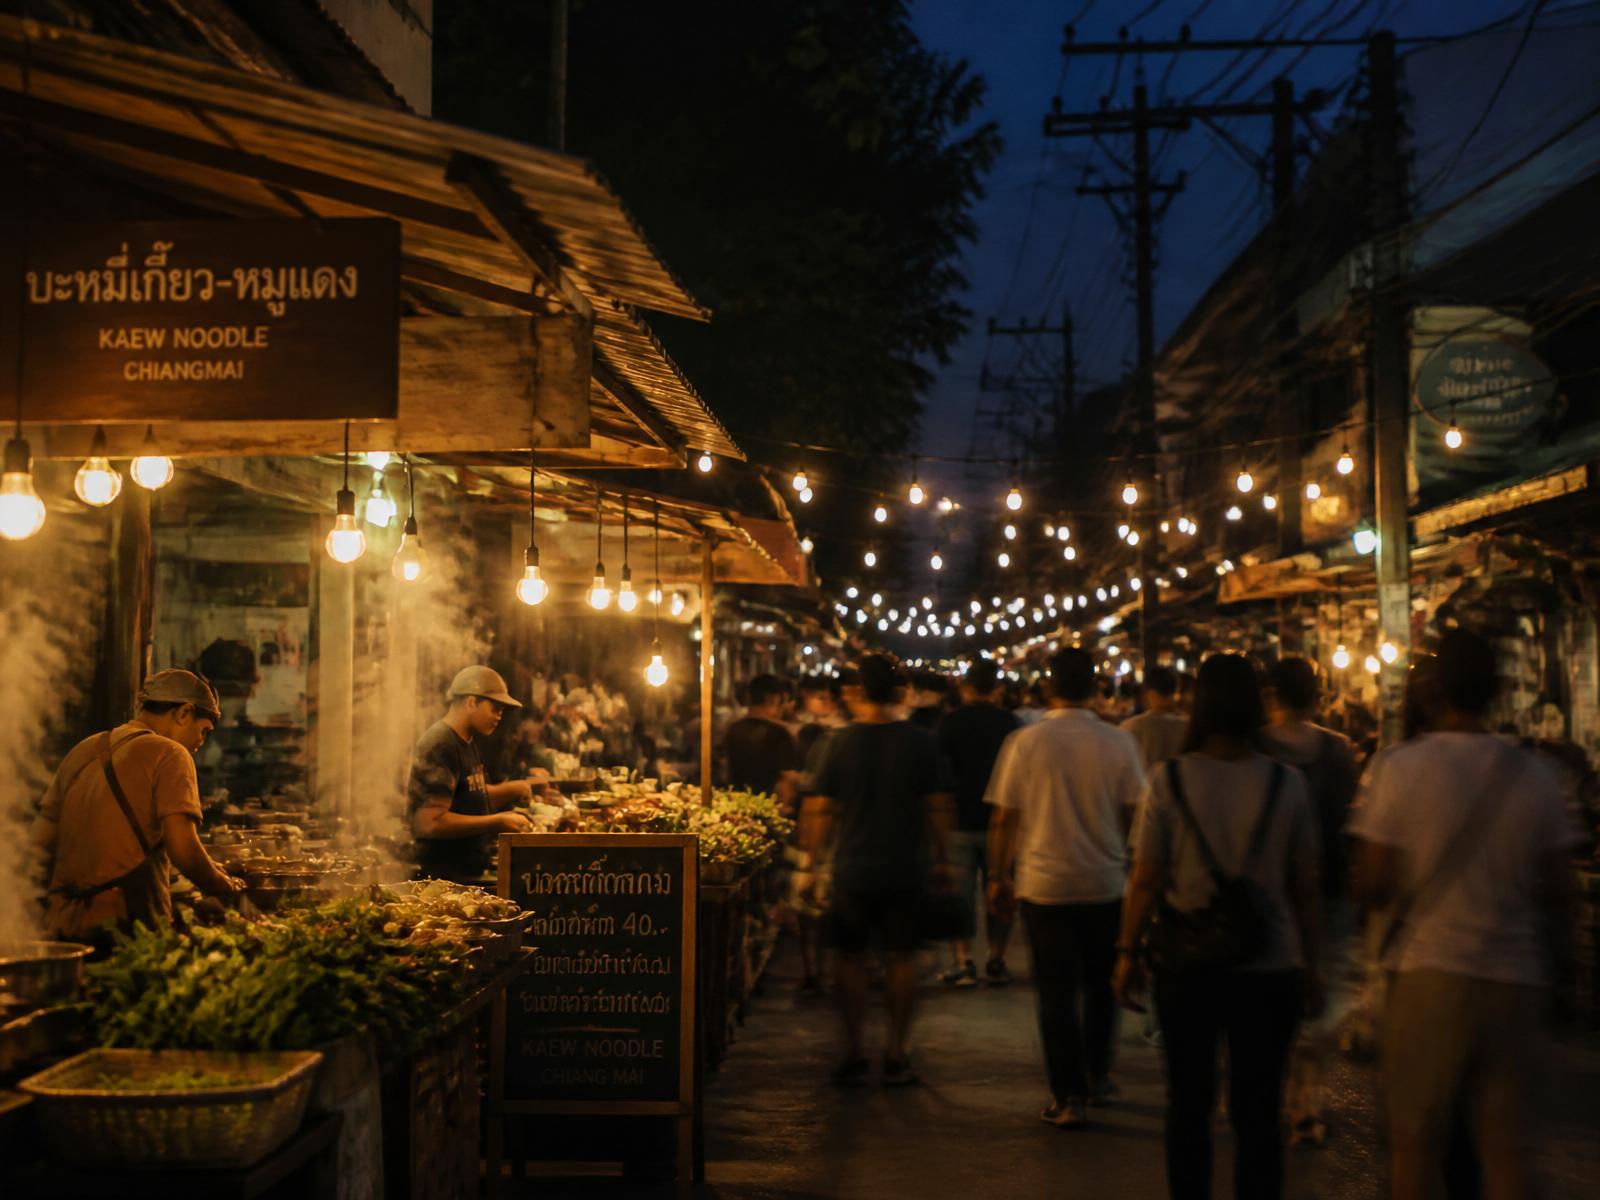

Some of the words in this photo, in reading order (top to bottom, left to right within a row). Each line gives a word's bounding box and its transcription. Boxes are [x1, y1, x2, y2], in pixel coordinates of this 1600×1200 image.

[25, 240, 359, 317] บะหมี่เกี้ยว-หมูแดง
[99, 329, 166, 349] KAEW
[173, 326, 270, 348] NOODLE
[123, 360, 245, 382] CHIANGMAI
[520, 1039, 577, 1057] KAEW
[584, 1039, 664, 1058] NOODLE
